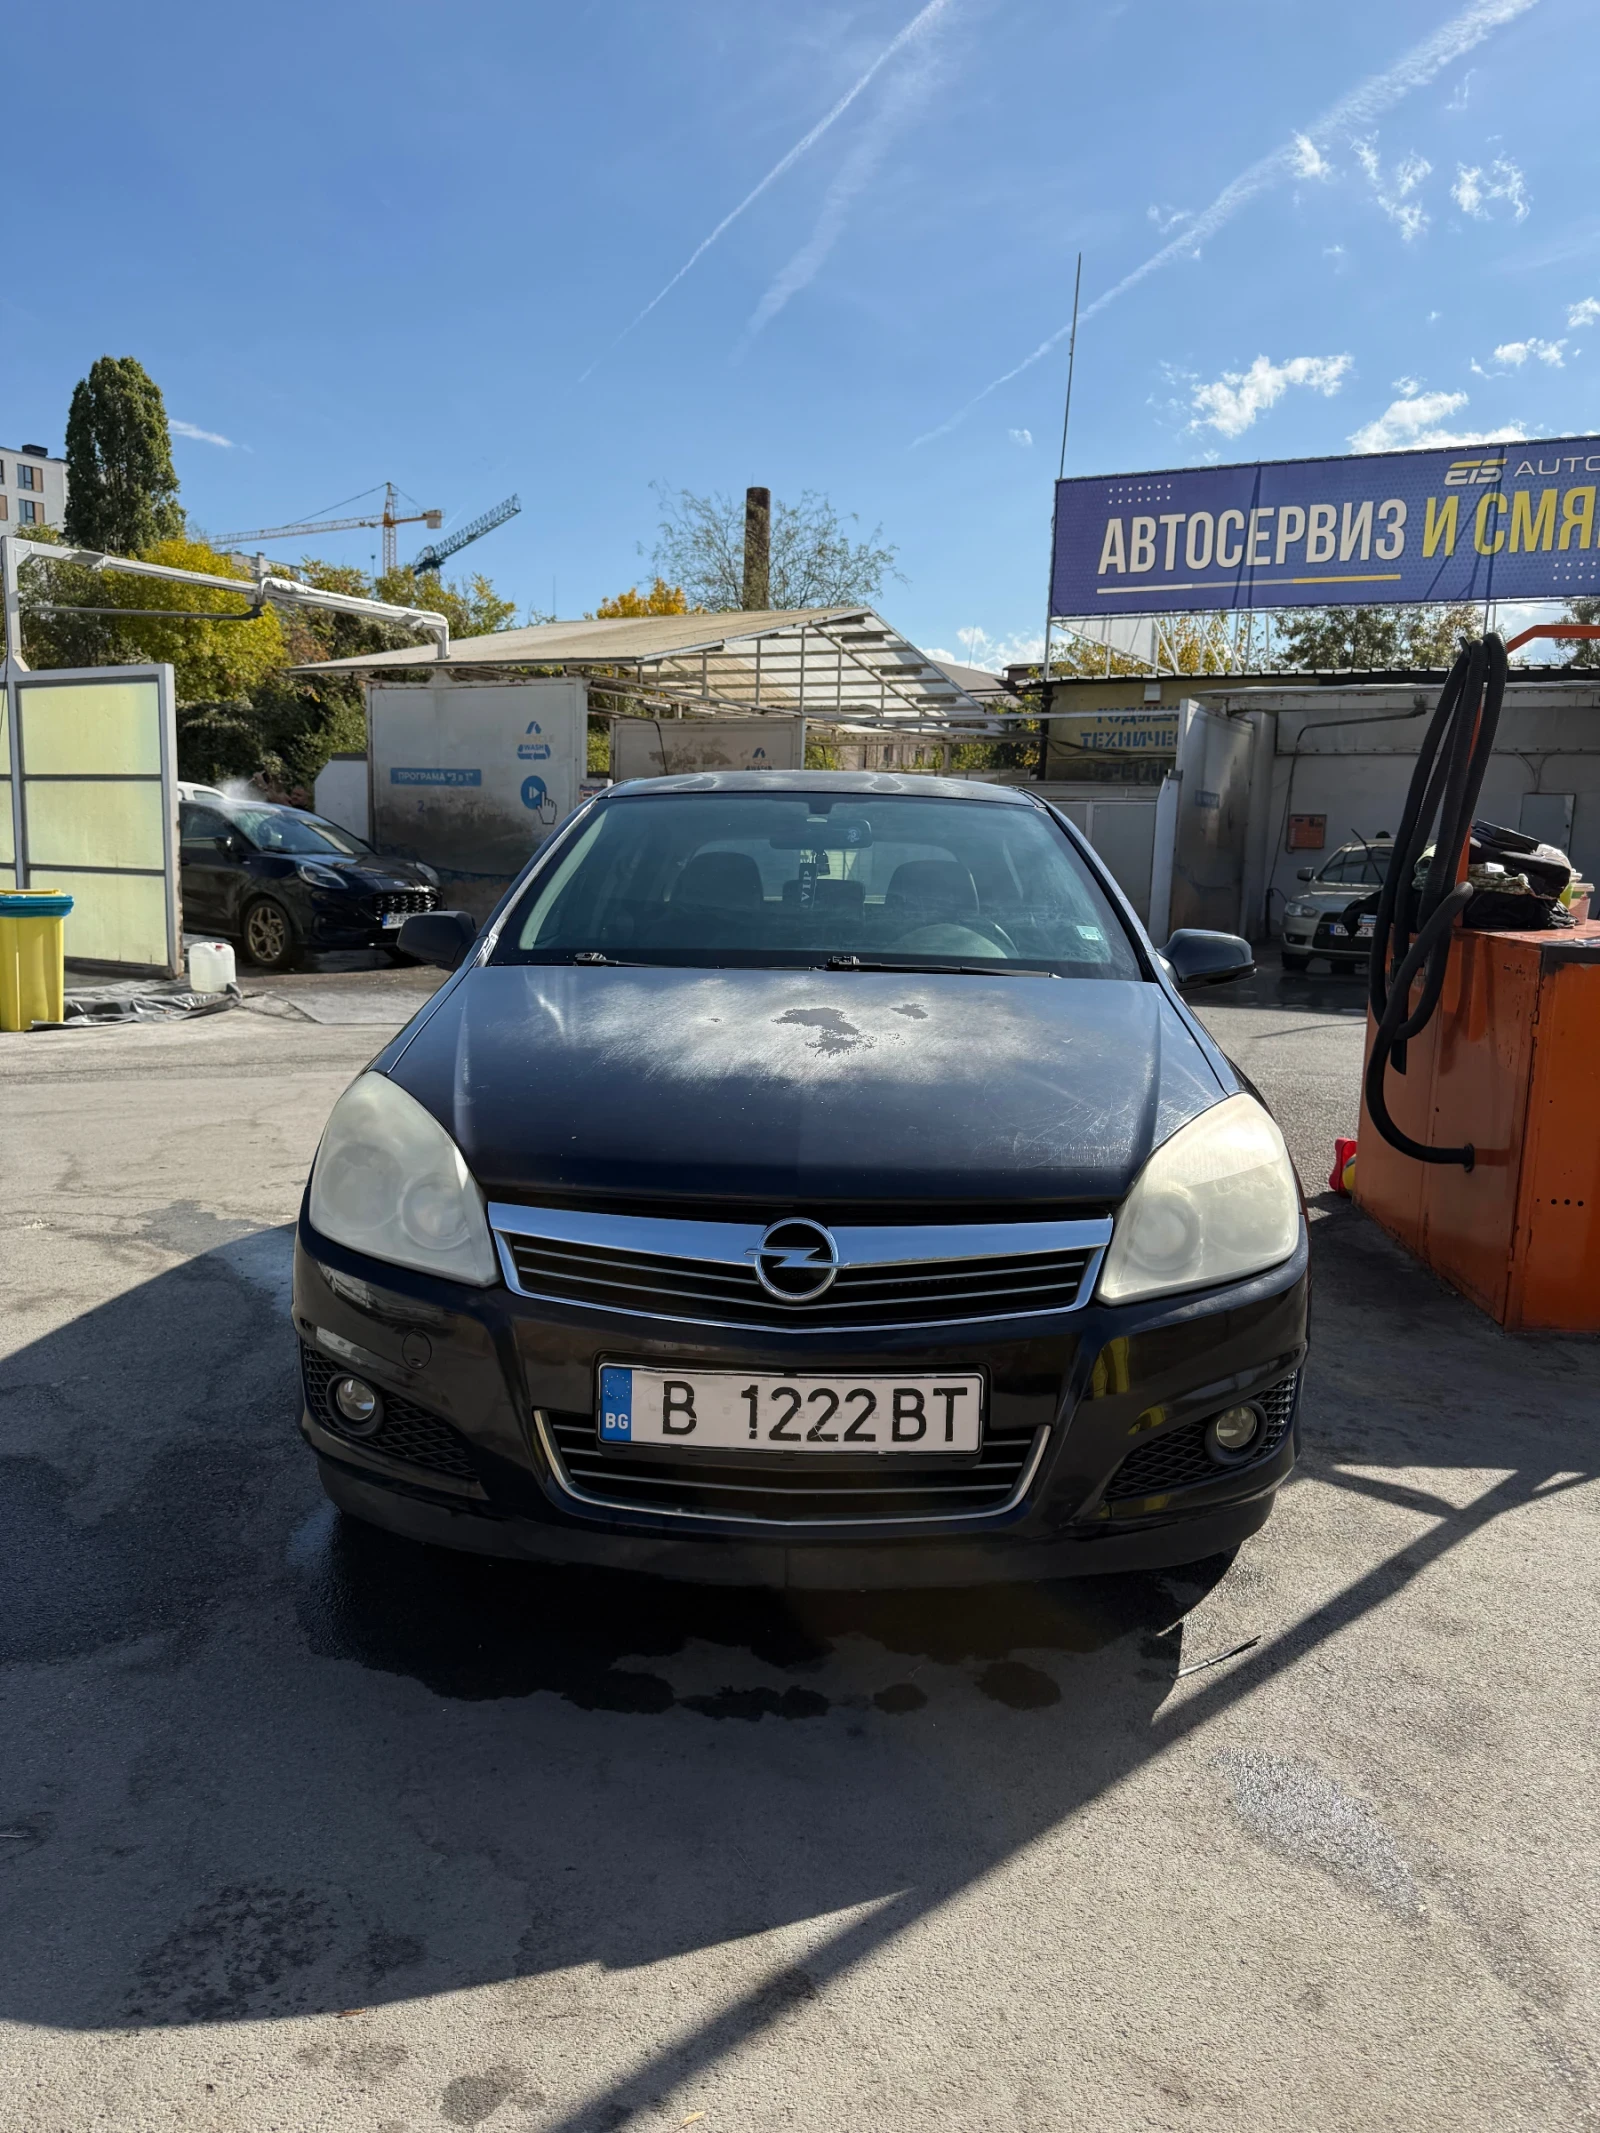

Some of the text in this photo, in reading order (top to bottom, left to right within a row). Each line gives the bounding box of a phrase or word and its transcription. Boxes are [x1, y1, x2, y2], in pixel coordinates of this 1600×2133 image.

[1097, 486, 1600, 575] АВТОСЕРВИЗ И СМЯ
[1080, 730, 1178, 748] ТЕХНИЧЕ
[398, 771, 446, 782] ПРОГРАМА
[605, 1413, 629, 1430] BG
[662, 1380, 697, 1436] B
